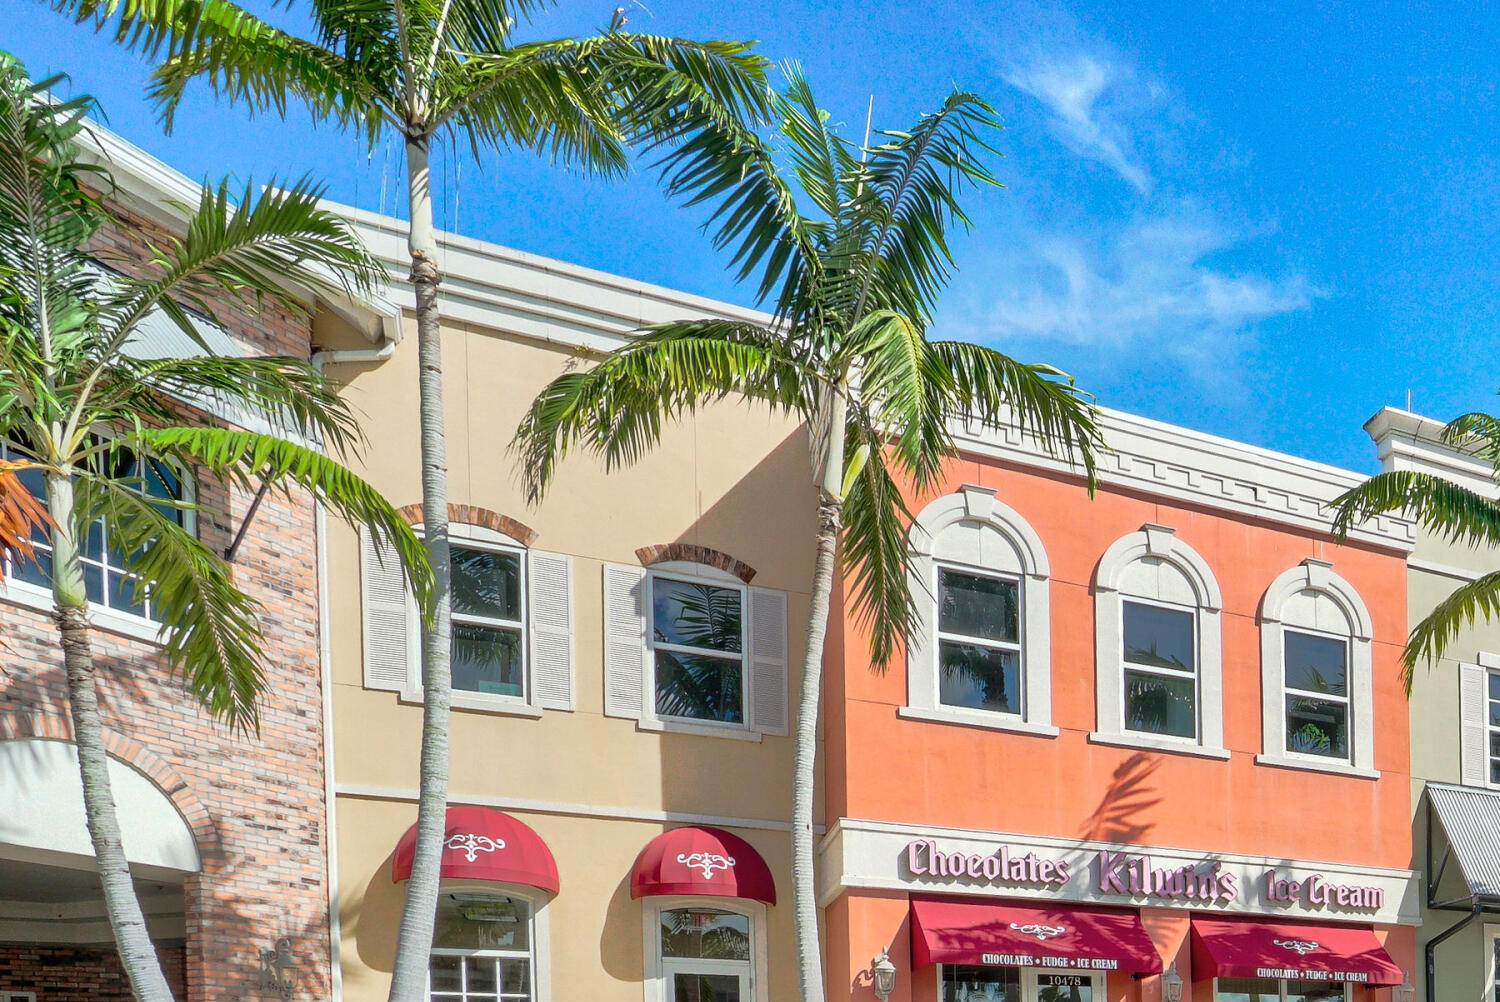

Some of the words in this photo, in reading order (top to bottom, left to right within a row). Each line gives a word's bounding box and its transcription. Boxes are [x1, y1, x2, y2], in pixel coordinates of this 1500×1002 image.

[907, 839, 1071, 886] Chocolates
[1099, 848, 1239, 902] Kilwin's
[1263, 868, 1301, 902] Ice
[1303, 873, 1385, 909] Cream
[982, 953, 1033, 966] CHOCOLATES
[1042, 956, 1068, 967] FUDGE
[1077, 958, 1090, 968] ICE
[1091, 959, 1118, 970] CREAM
[1257, 967, 1299, 979] CHOCOLATES
[1305, 970, 1328, 980] FUDGE
[1334, 971, 1345, 981] ICE
[1346, 972, 1368, 982] CREAM
[1048, 975, 1081, 986] 10478
